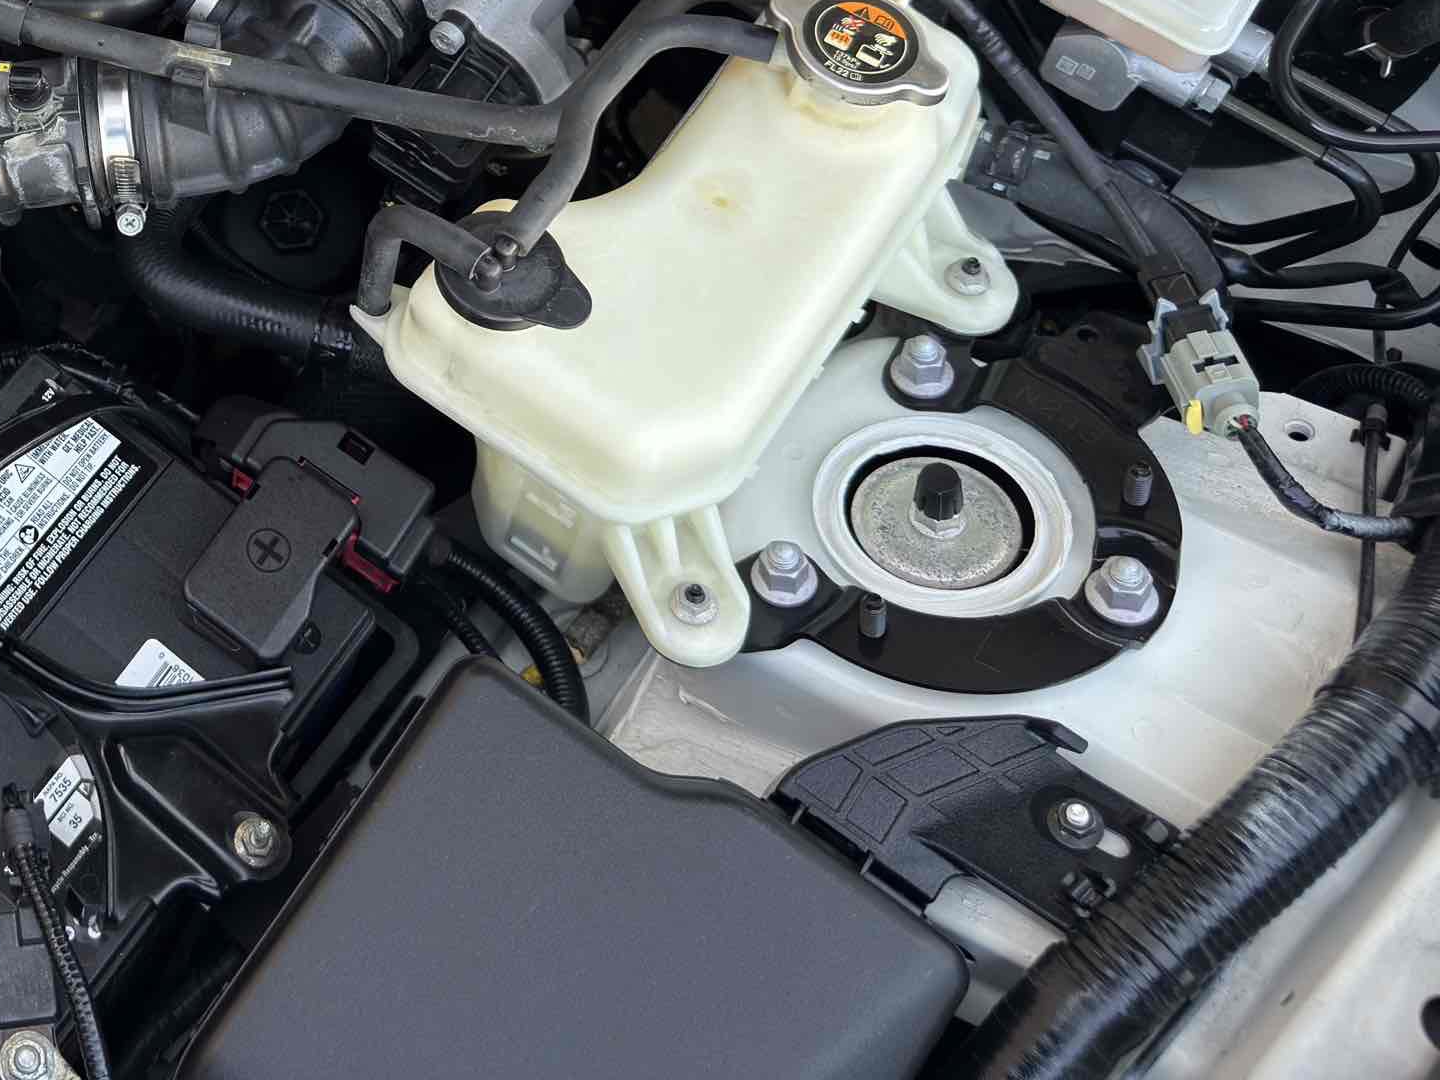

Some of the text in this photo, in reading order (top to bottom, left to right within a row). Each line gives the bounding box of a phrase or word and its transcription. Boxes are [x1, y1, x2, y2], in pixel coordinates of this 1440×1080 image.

[39, 386, 56, 403] 12V
[61, 417, 93, 454] GET MEDICAL
[73, 437, 89, 454] HELP
[37, 448, 54, 466] WITH
[62, 475, 72, 486] DO
[67, 465, 81, 480] NOT
[77, 451, 93, 468] OPEN
[68, 481, 79, 491] DO
[74, 469, 88, 485] NOT
[10, 565, 30, 585] RISK
[23, 556, 37, 570] OF
[44, 507, 78, 545] EXPLOSION
[72, 498, 86, 512] OR
[98, 466, 113, 480] DO
[106, 453, 123, 471] NOT
[27, 565, 42, 581] OR
[35, 529, 72, 571] INCINERATE.
[66, 516, 83, 535] NOT
[76, 472, 120, 522] RECOMMENDED
[113, 460, 130, 478] FOR
[29, 498, 53, 524] READ ALL
[19, 584, 38, 604] USE.
[32, 558, 60, 589] FOLLOW
[53, 534, 80, 564] PROPER
[74, 504, 106, 540] CHARGING
[99, 460, 142, 510] INSTRUCTIONS.
[47, 776, 73, 804] 7535
[67, 812, 84, 830] 35
